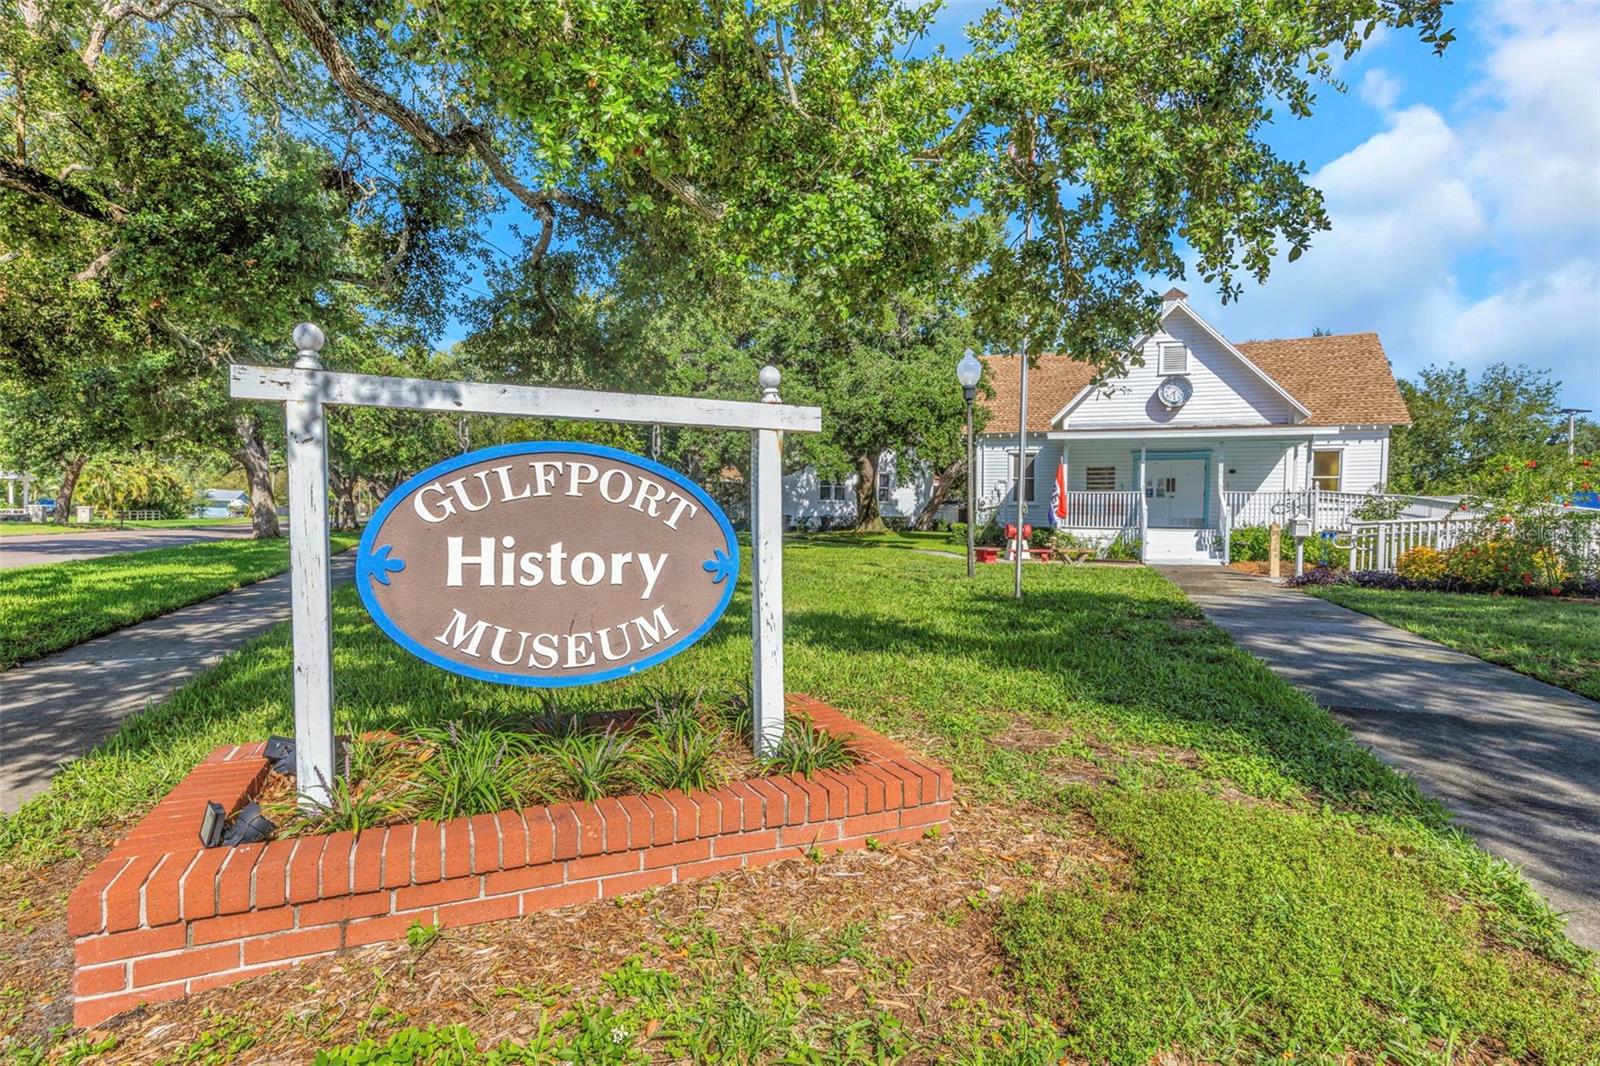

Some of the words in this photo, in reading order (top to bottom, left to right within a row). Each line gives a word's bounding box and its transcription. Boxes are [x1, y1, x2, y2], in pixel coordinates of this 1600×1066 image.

[413, 461, 698, 530] GULFPORT
[446, 535, 669, 599] History
[434, 604, 679, 669] MUSEUM
